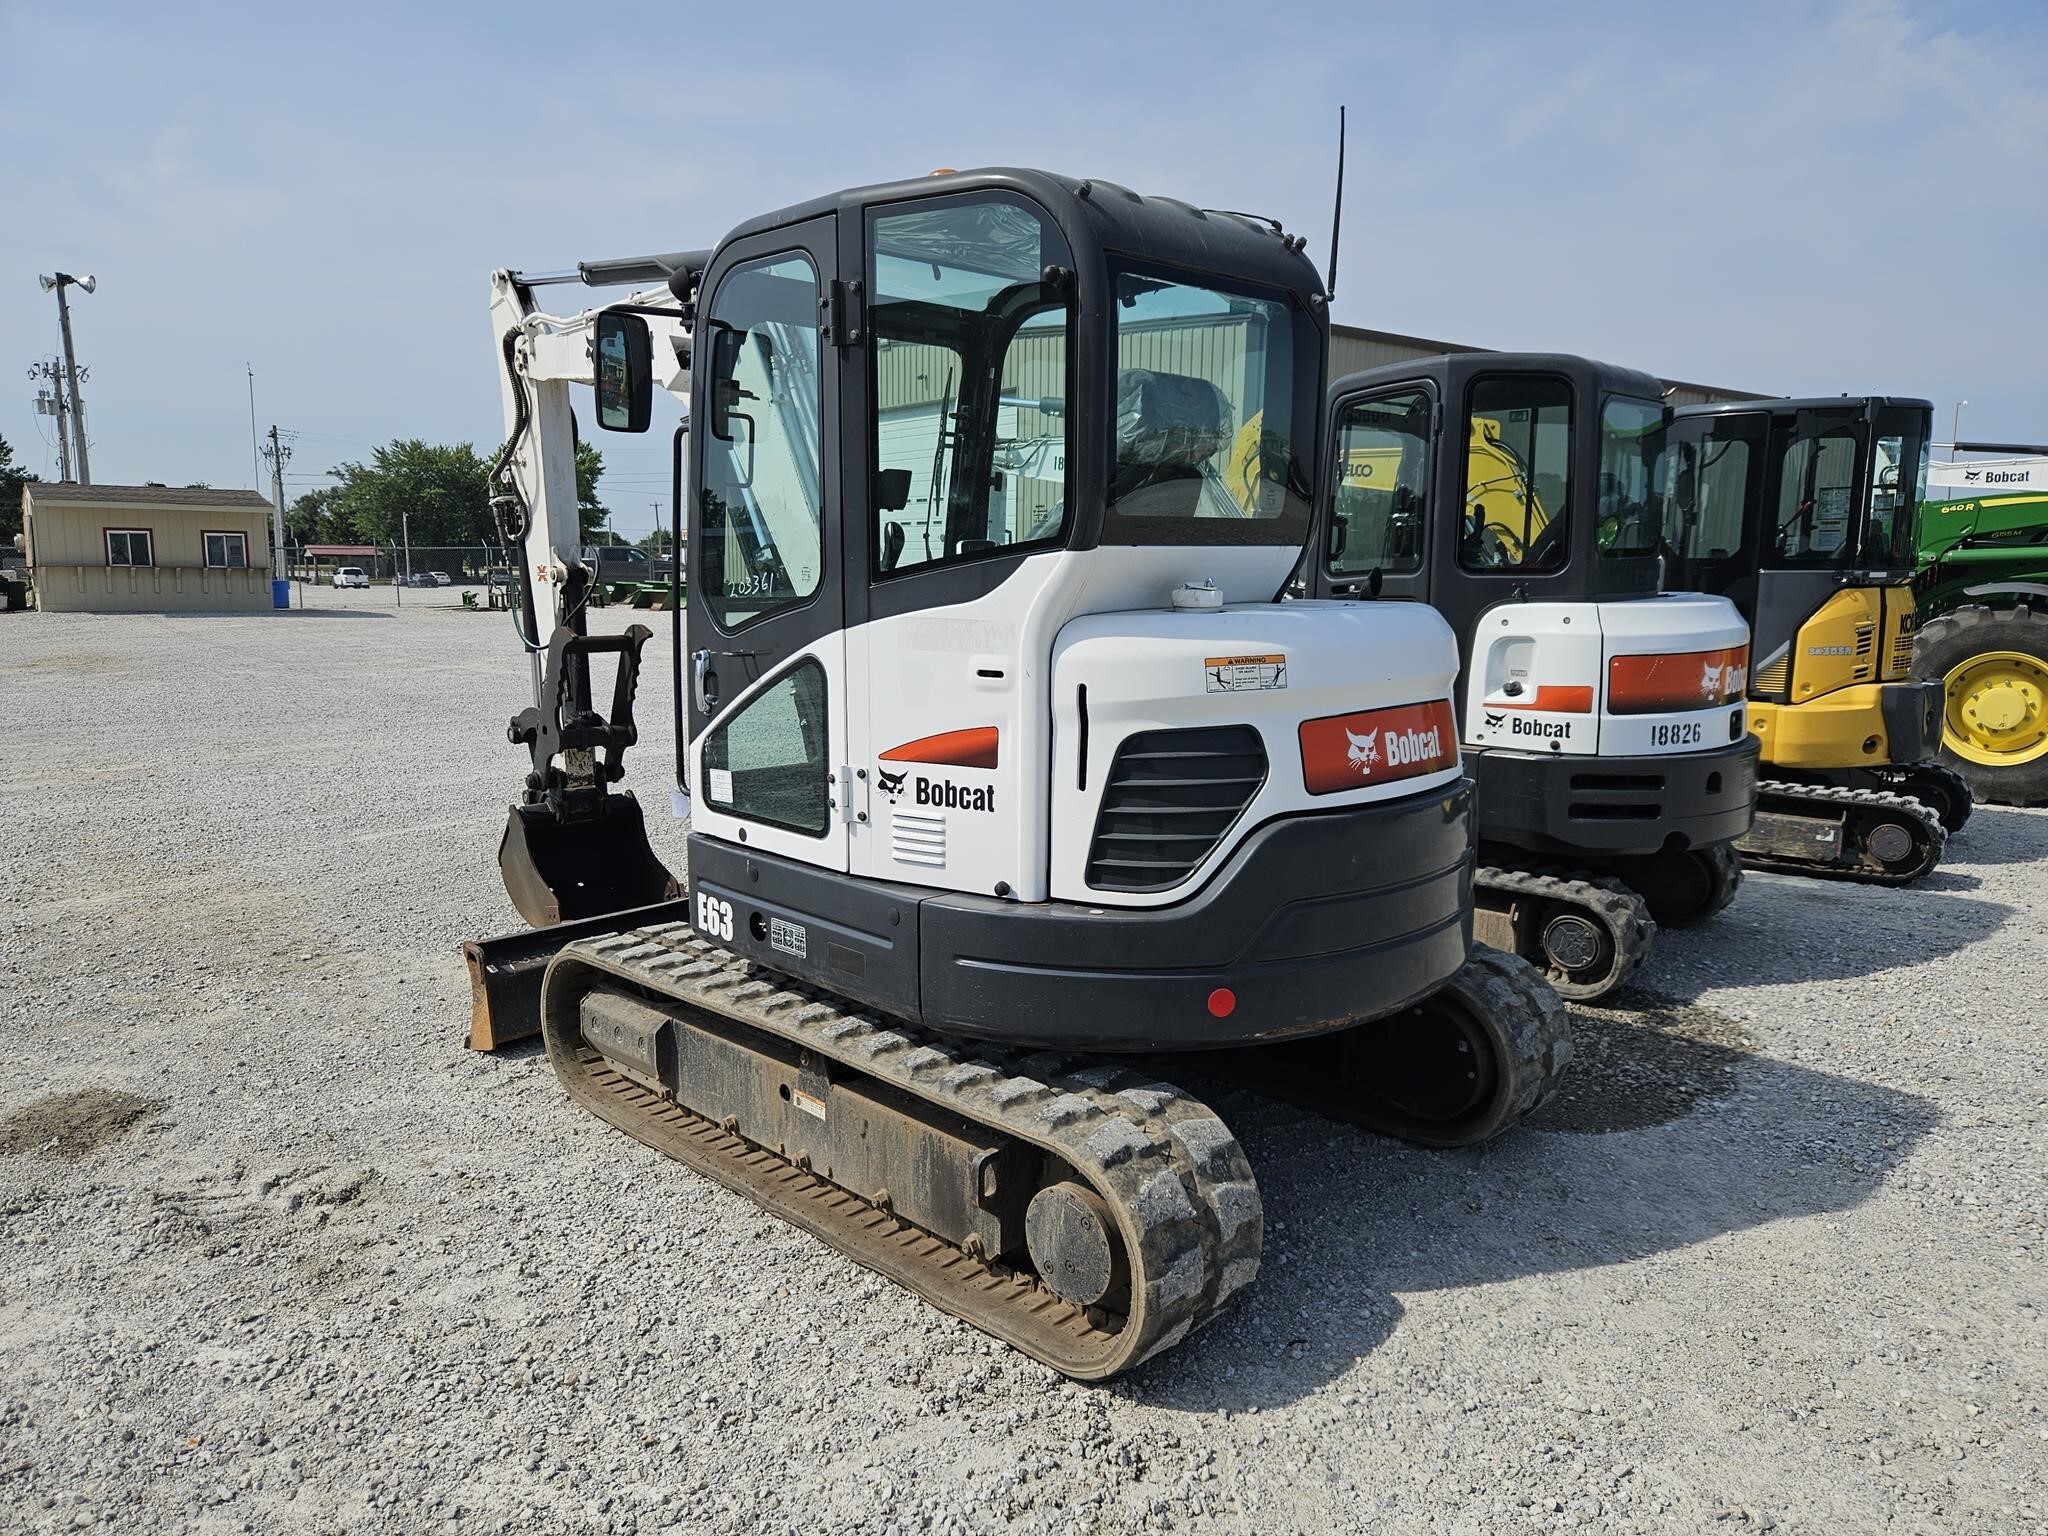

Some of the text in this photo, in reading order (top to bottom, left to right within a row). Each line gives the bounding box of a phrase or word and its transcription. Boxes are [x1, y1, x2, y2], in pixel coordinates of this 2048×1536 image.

[1054, 456, 1064, 471] 18
[1346, 463, 1373, 477] ELCO
[1985, 470, 2030, 483] Bobcat
[727, 572, 774, 598] 203361
[1512, 717, 1572, 739] Bobcat
[1651, 722, 1702, 746] 18826
[1384, 725, 1442, 767] Bobcat
[915, 776, 995, 813] Bobcat
[696, 891, 734, 943] E63
